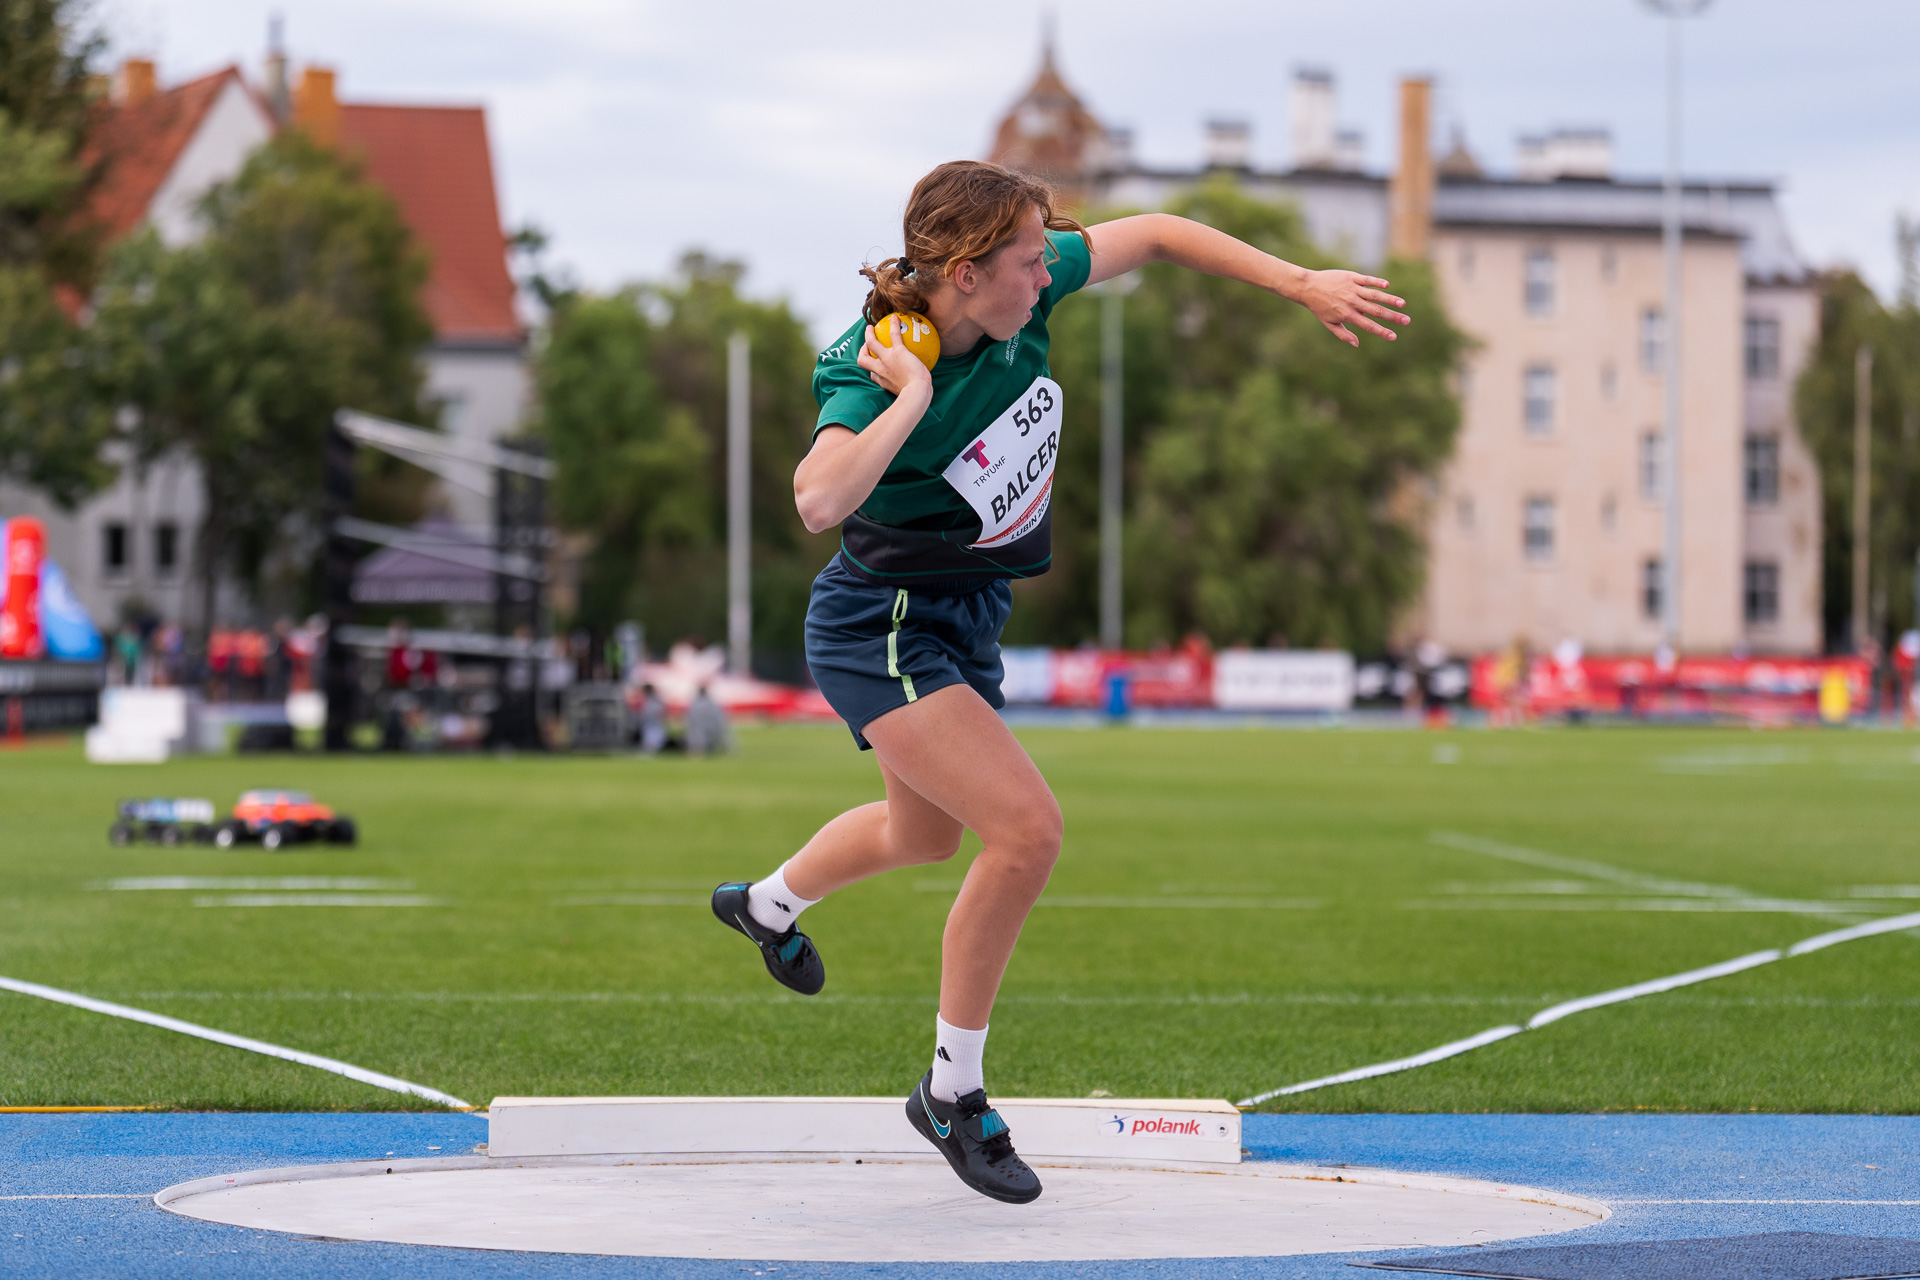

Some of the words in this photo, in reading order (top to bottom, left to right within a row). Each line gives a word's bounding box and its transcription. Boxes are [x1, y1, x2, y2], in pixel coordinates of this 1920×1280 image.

[1012, 387, 1054, 437] 563
[973, 456, 1007, 488] TRYUMF
[990, 430, 1058, 525] BALCER
[1010, 515, 1037, 540] LUBIN
[1131, 1117, 1202, 1136] polanik
